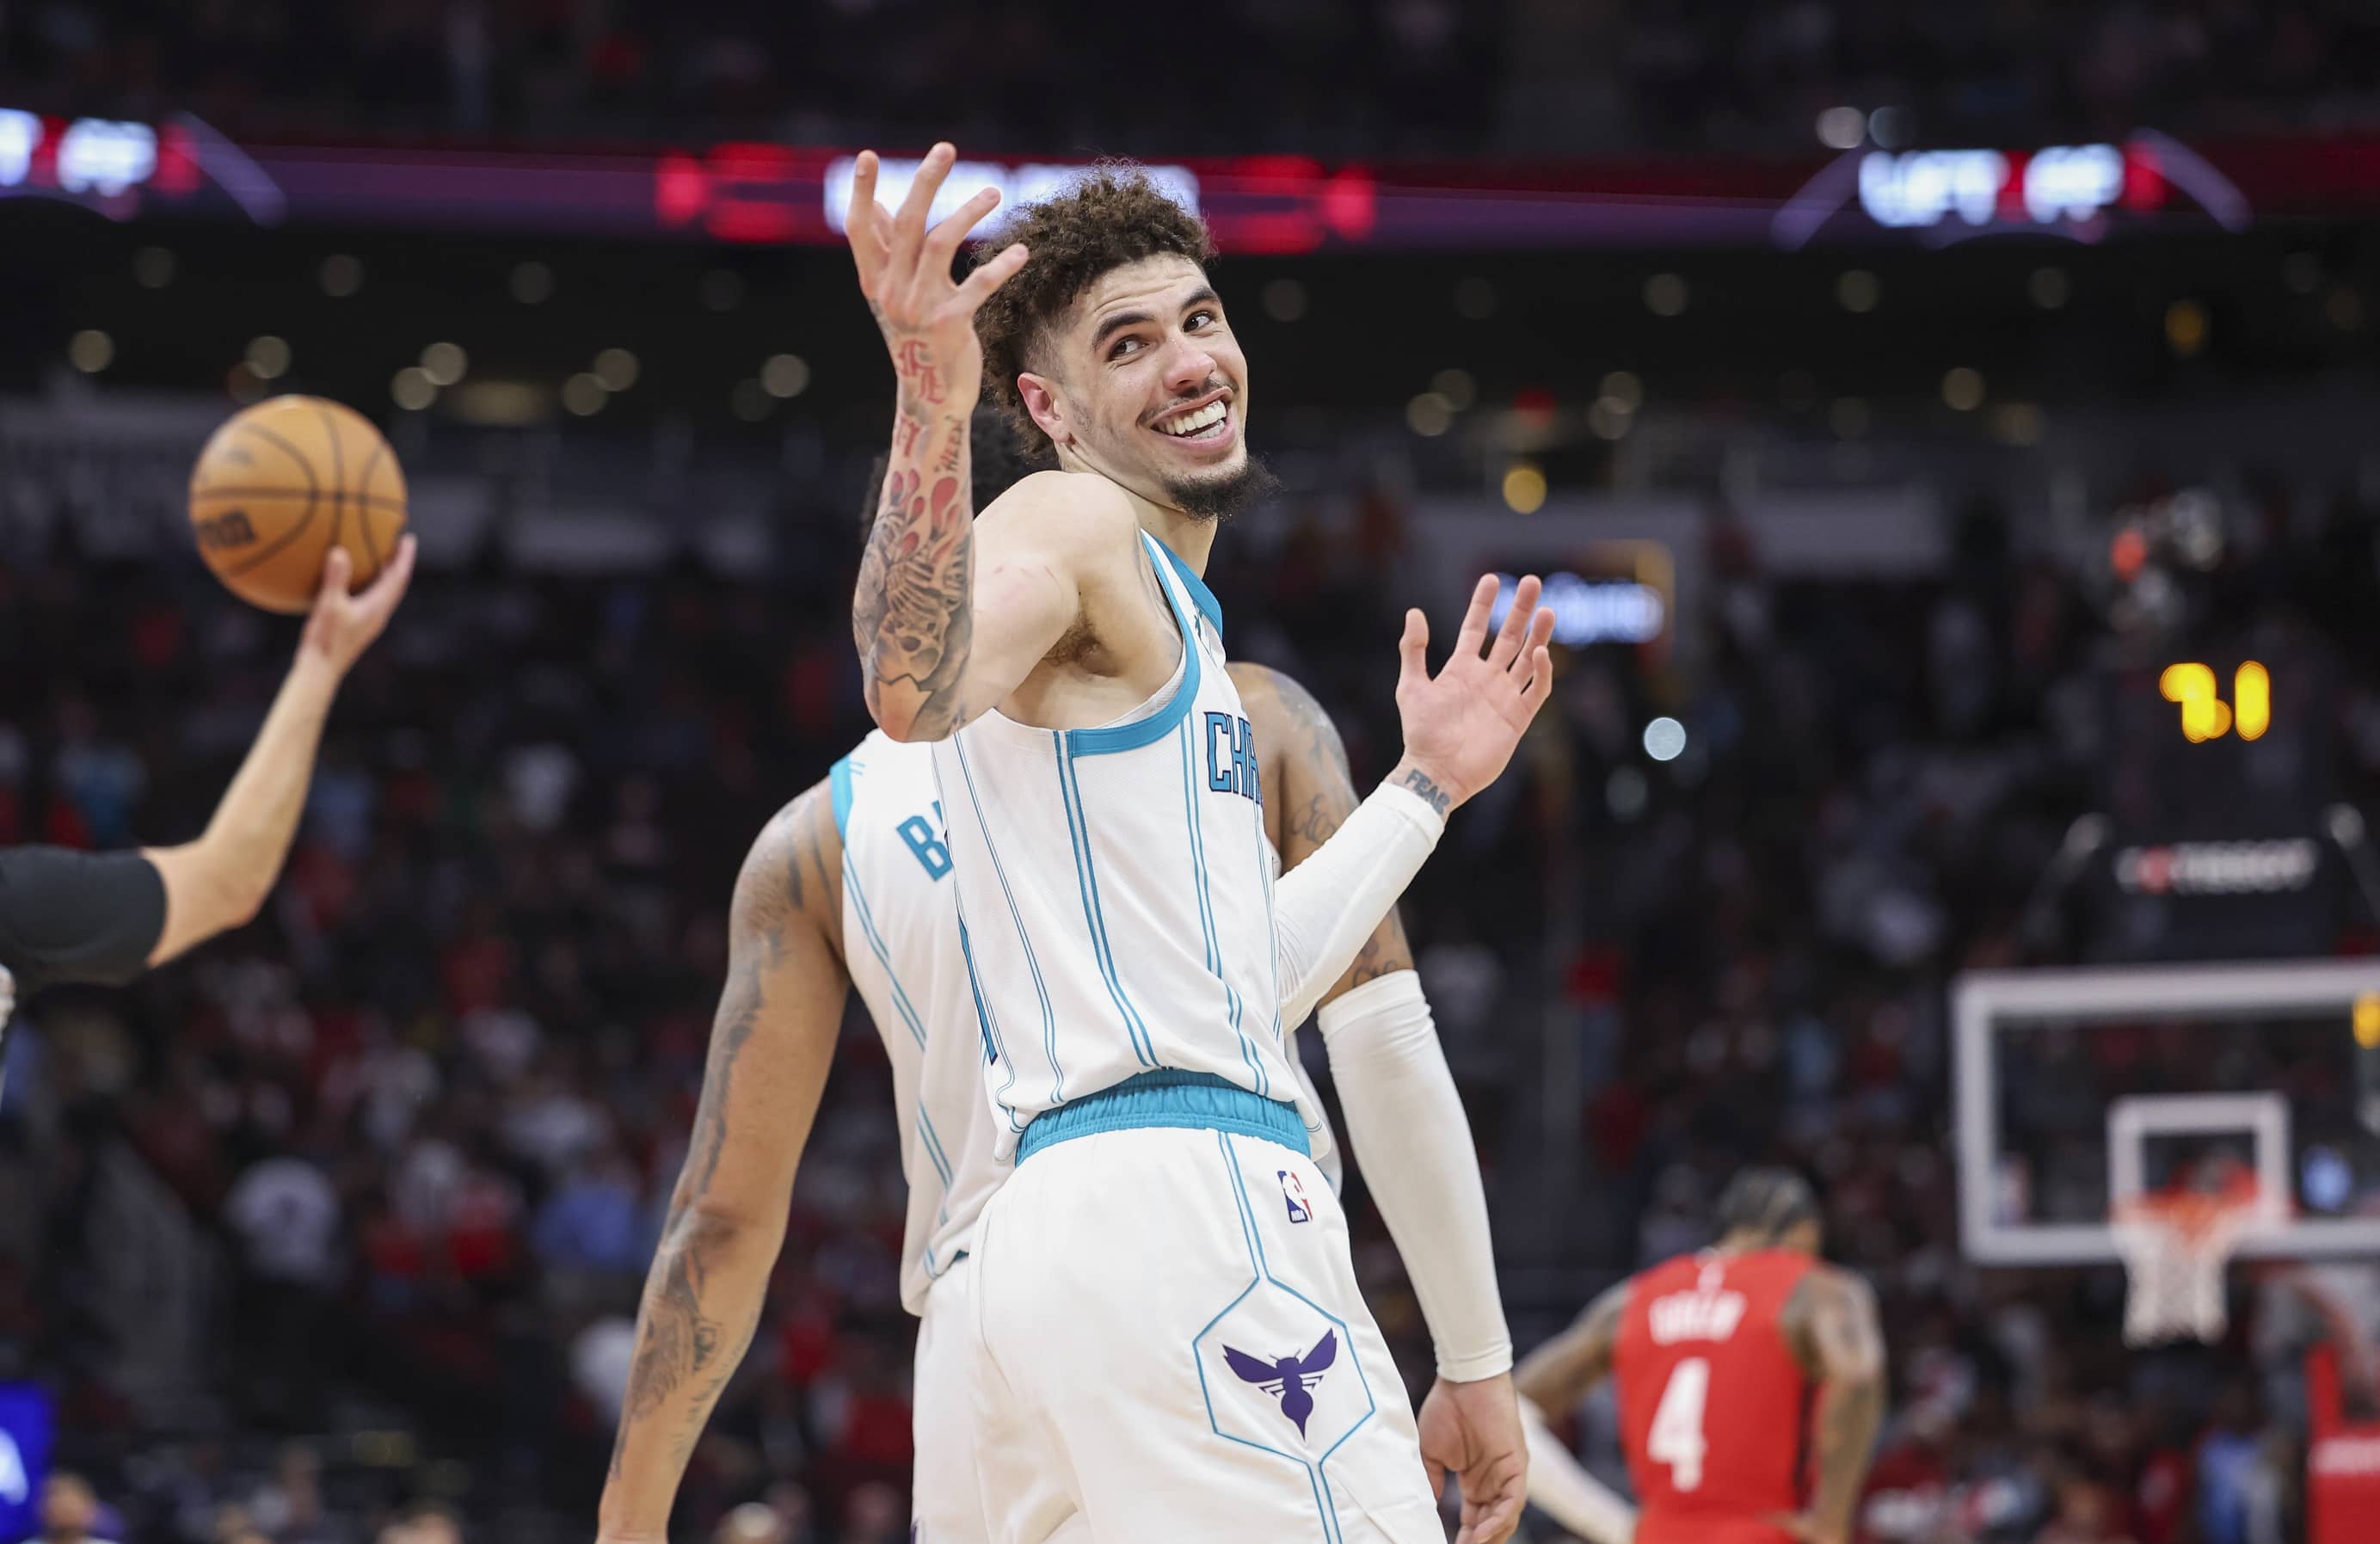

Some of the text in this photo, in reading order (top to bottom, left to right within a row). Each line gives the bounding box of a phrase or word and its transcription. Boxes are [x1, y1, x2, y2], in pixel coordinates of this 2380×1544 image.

[1204, 711, 1264, 806] CHA
[1405, 768, 1450, 815] FEAR
[895, 800, 954, 882] B
[1647, 1356, 1709, 1492] 4
